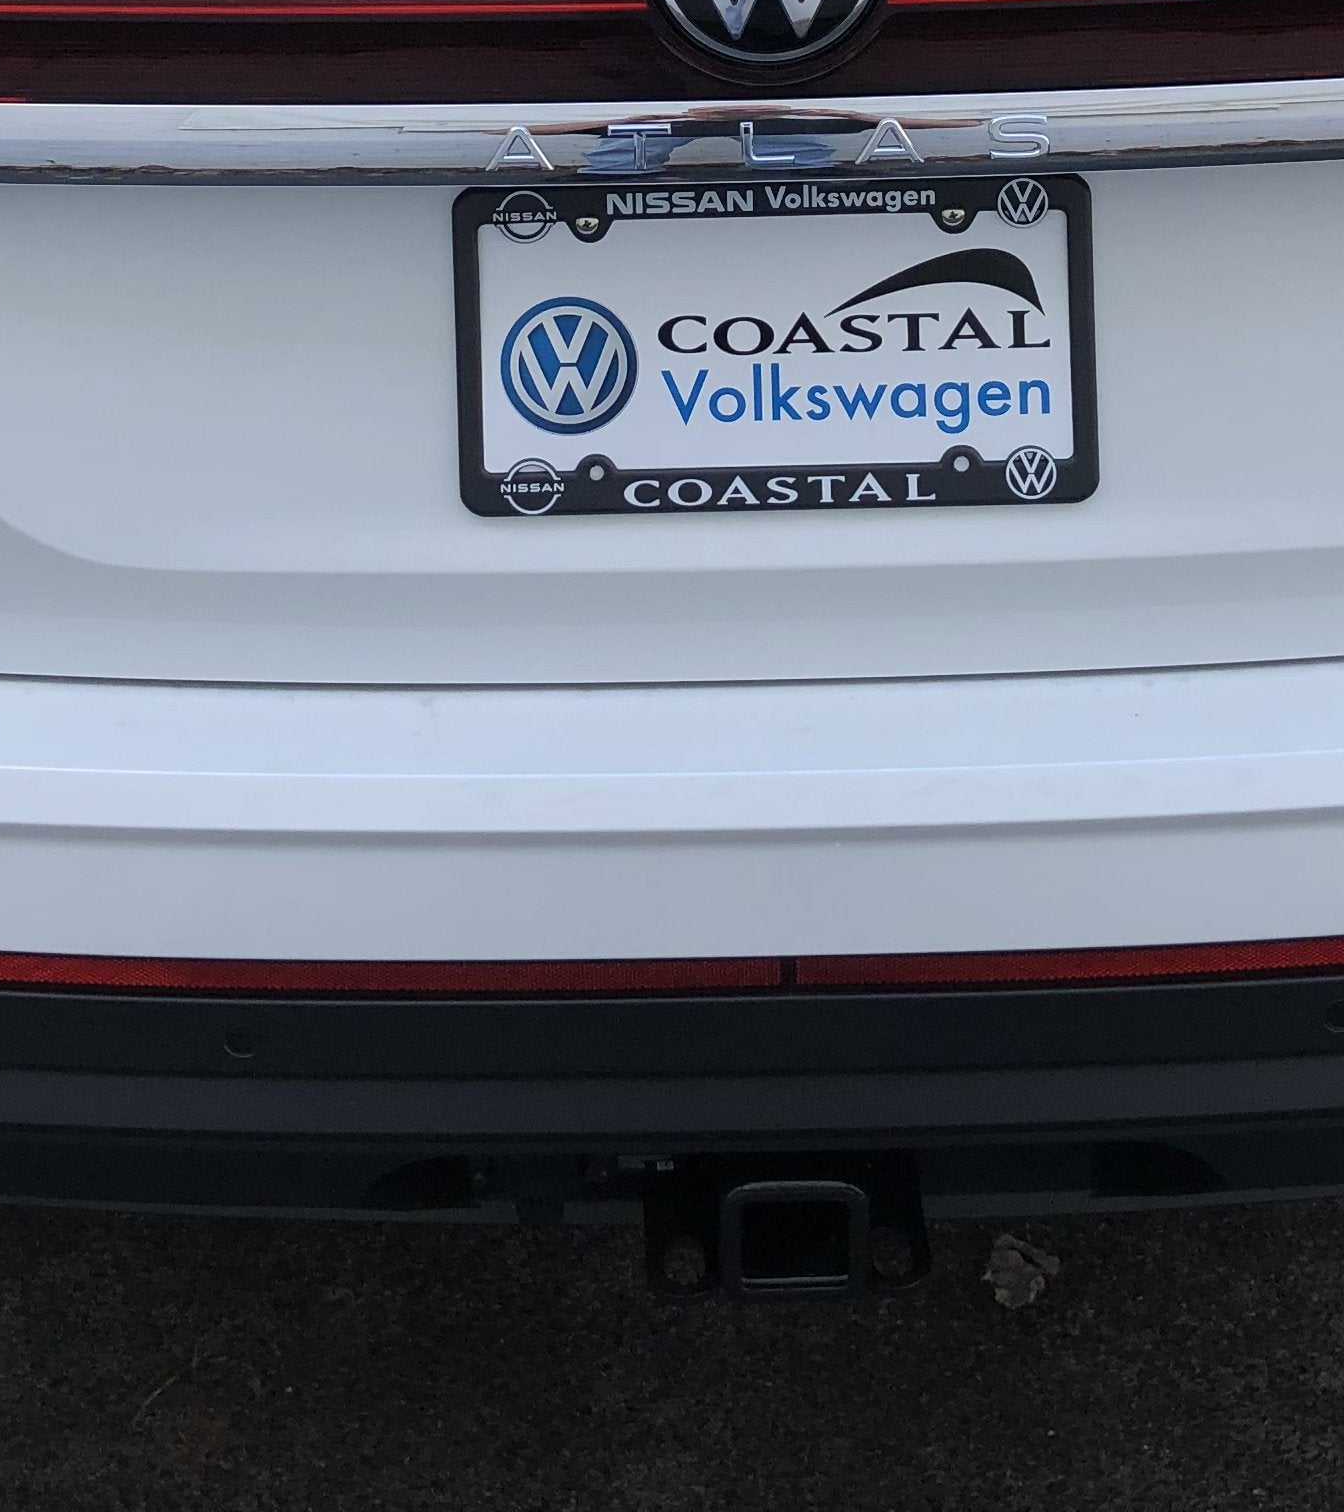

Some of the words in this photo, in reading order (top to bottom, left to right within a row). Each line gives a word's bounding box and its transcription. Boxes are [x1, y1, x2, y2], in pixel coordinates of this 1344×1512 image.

[484, 113, 1052, 173] ATLAS
[492, 210, 558, 223] NISSAN
[606, 189, 754, 216] NISSAN
[764, 184, 937, 213] Volkswagen
[657, 306, 1052, 356] COASTAL
[661, 362, 1052, 435] Volkswagen
[499, 482, 565, 494] NISSAN
[623, 472, 937, 508] COASTAL
